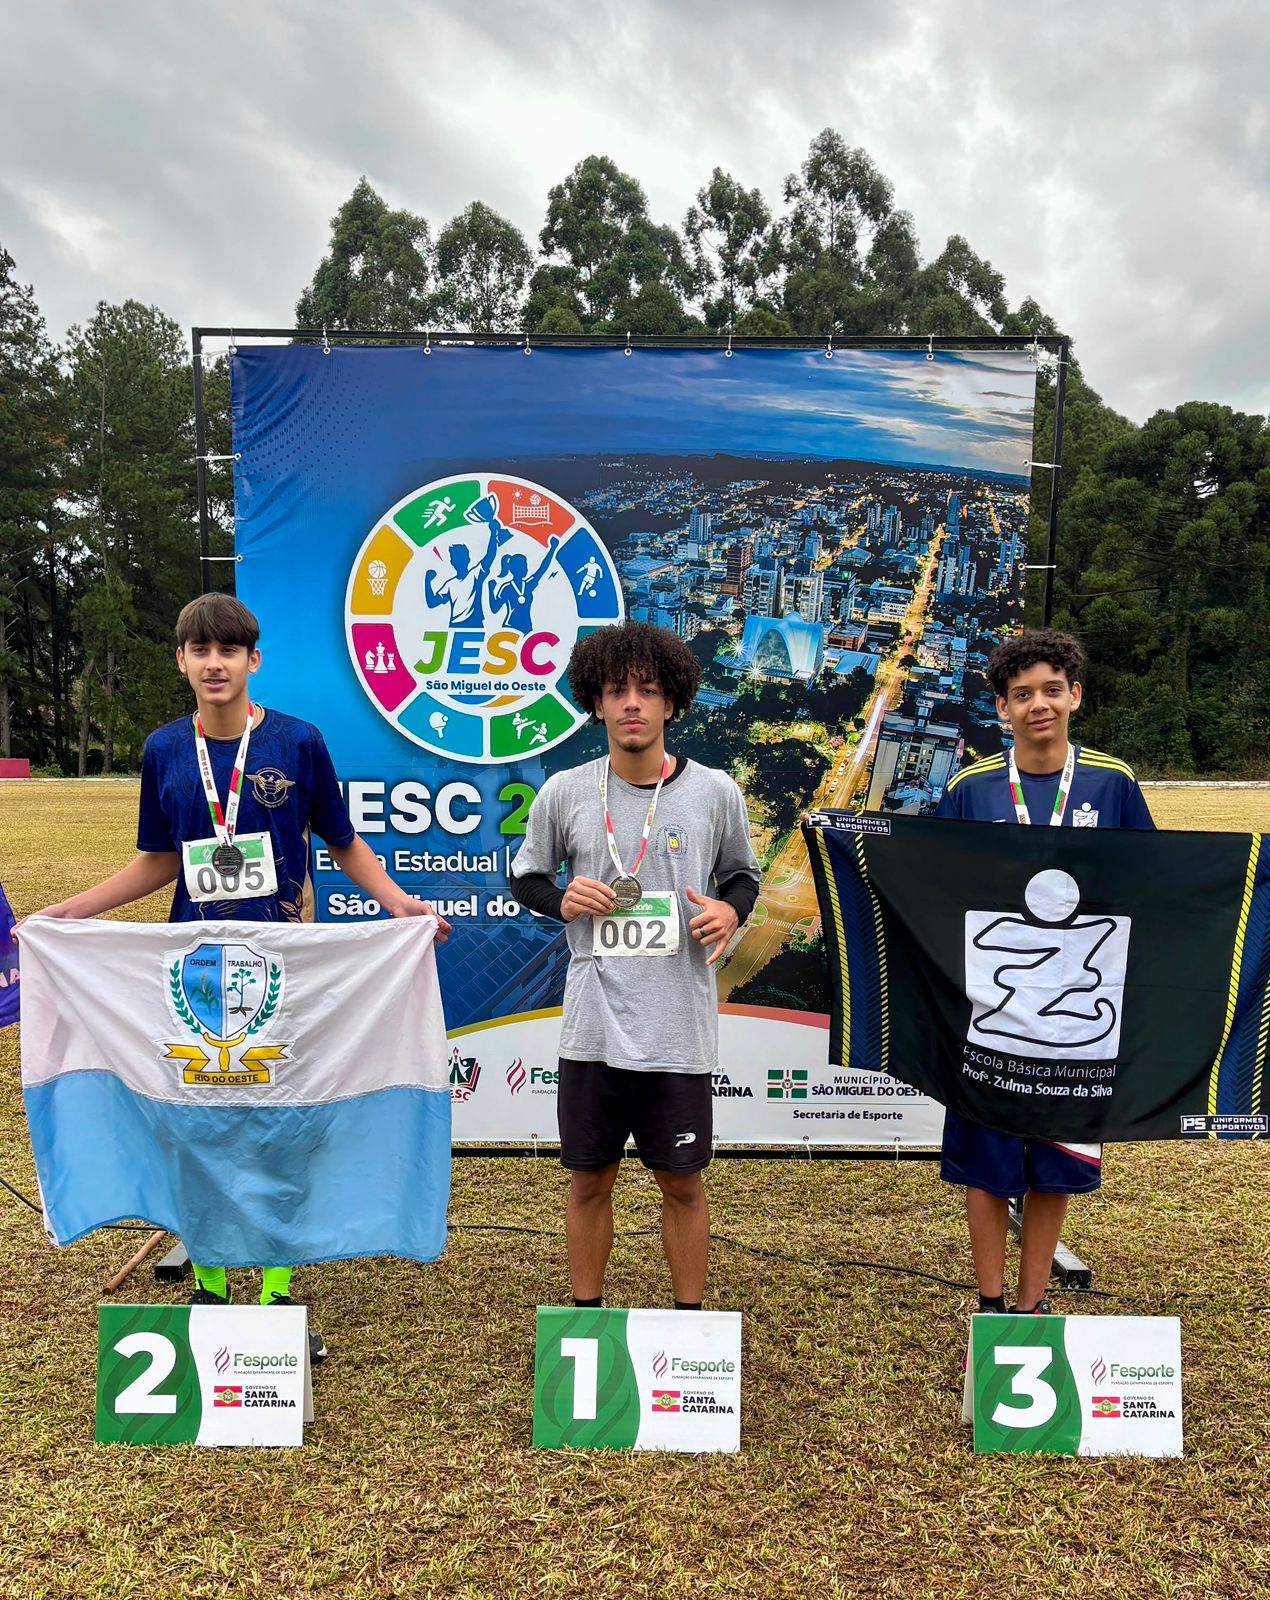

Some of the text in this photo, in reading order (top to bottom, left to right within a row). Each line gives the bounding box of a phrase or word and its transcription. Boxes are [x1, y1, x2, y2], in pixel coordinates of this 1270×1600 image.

[413, 631, 561, 675] JESC
[426, 680, 546, 693] São Miguel do Oeste
[337, 781, 482, 834] ESC
[809, 813, 832, 826] PS
[836, 816, 887, 826] UNIFORMES
[835, 822, 889, 832] ESPORTIVOS
[394, 850, 498, 872] Estadual
[328, 892, 381, 916] São
[486, 895, 520, 917] do
[600, 919, 667, 950] 002
[189, 958, 263, 968] ORDEM TRABALHO
[963, 1046, 1117, 1081] Escola Básica Municipal
[194, 1074, 259, 1083] RIO DO OESTE
[833, 1075, 891, 1085] MUNICÍPIO
[711, 1086, 754, 1097] ARINA
[811, 1083, 925, 1097] SÃO MIGUEL DO OES
[993, 1075, 1033, 1095] Zulma
[1035, 1083, 1070, 1096] Souza
[1072, 1084, 1088, 1098] da
[1091, 1084, 1113, 1098] Silva
[793, 1110, 903, 1121] Secretaria de Esporte
[1183, 1117, 1206, 1131] PS
[234, 1353, 298, 1370] Fesporte
[671, 1358, 735, 1375] Fesporte
[113, 1331, 177, 1414] 2
[561, 1337, 599, 1420] 1
[1110, 1364, 1175, 1380] Fesporte
[991, 1346, 1057, 1429] 3
[244, 1391, 278, 1399] SANTA
[682, 1395, 716, 1404] SANTA
[244, 1399, 296, 1408] CATARINA
[682, 1405, 734, 1414] CATARINA
[1122, 1401, 1157, 1409] SANTA
[1122, 1410, 1175, 1418] CATARINA
